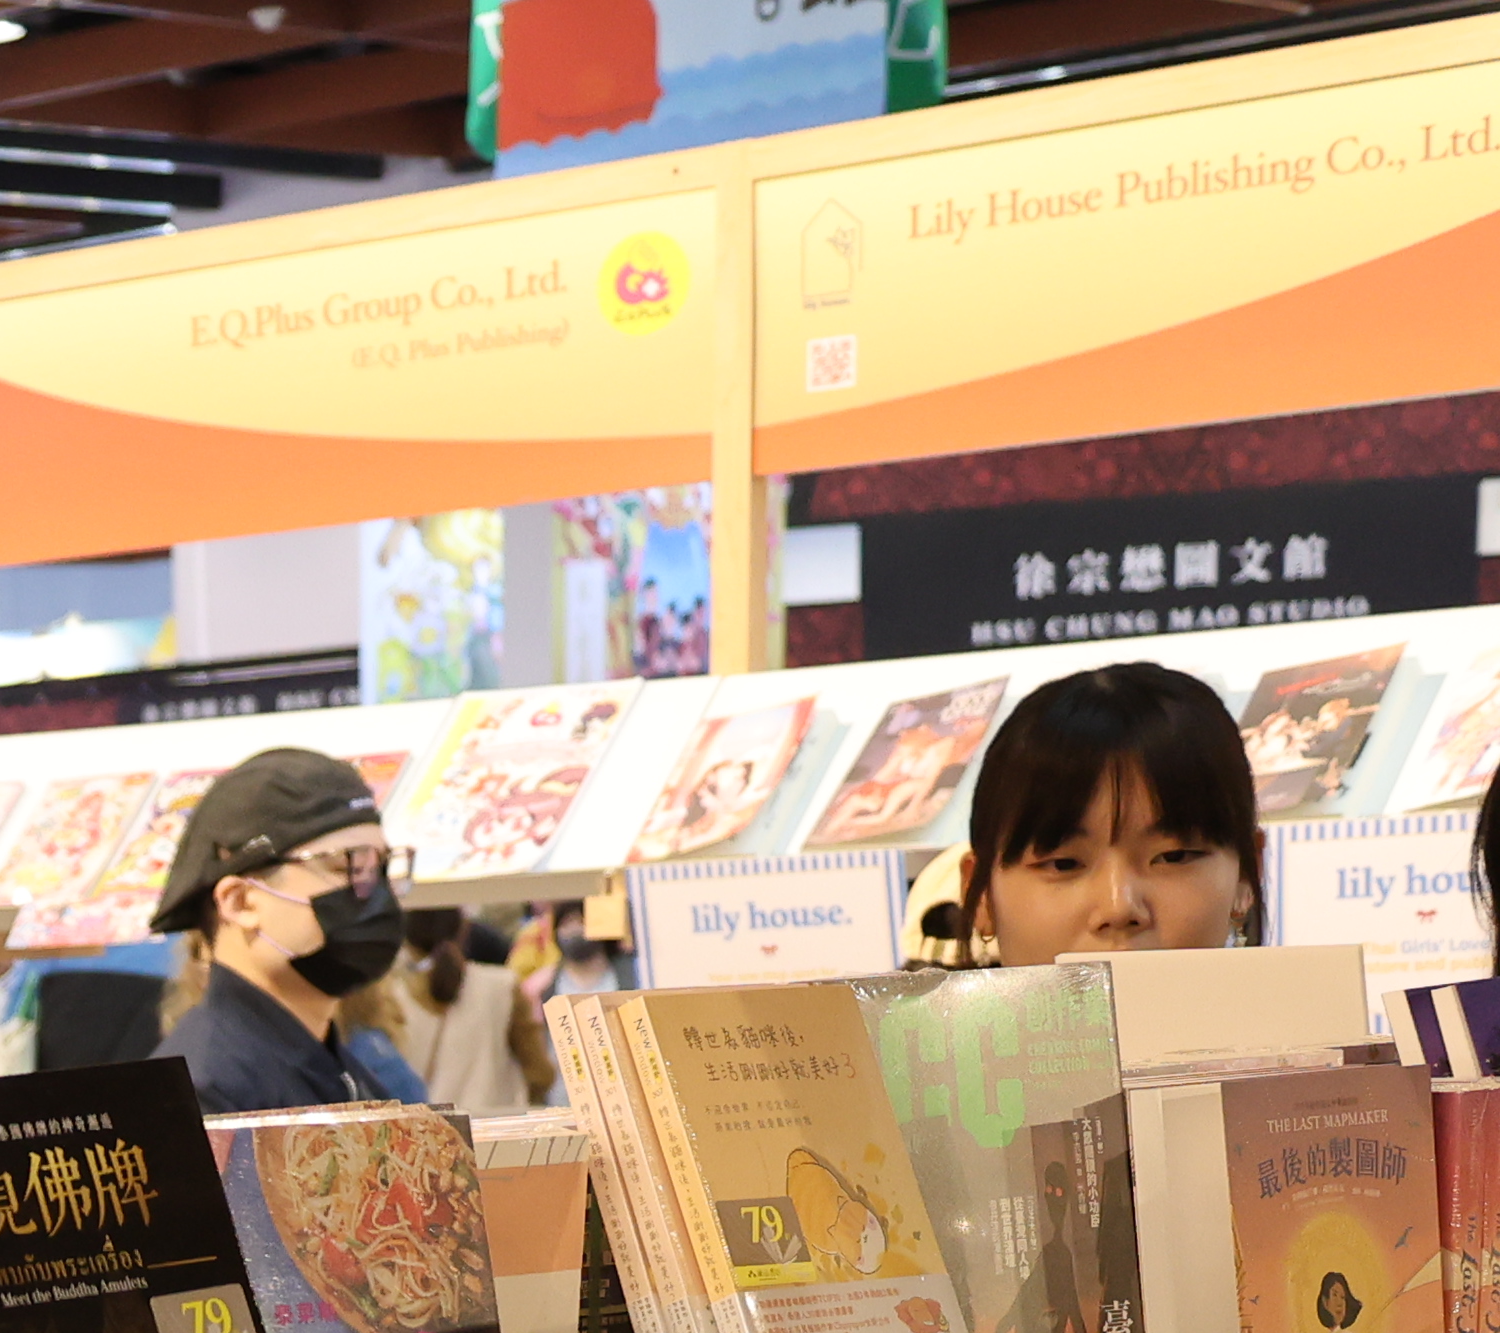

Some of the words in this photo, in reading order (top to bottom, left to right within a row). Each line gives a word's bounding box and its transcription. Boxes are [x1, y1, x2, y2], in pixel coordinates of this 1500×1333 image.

[909, 203, 975, 245] Lily
[986, 181, 1101, 228] House
[1116, 150, 1317, 208] Publishing
[1326, 134, 1406, 175] Co.,
[1420, 113, 1500, 163] Ltd.
[324, 287, 421, 332] Group
[431, 275, 496, 308] Co.,
[505, 261, 568, 300] Ltd.
[1012, 533, 1329, 601] 徐宗懋圖文館
[970, 617, 1036, 648] HSU
[1045, 608, 1160, 643] CHUNG
[1168, 603, 1241, 633] MAO
[1248, 593, 1370, 627] STUDIO
[1337, 868, 1395, 907] lily
[692, 901, 739, 935] lily
[747, 901, 853, 930] house.
[1266, 1117, 1292, 1135] THE
[1293, 1114, 1322, 1133] LAST
[1323, 1108, 1390, 1129] MAPMAKER
[1257, 1136, 1408, 1201] 最後的製圖師
[740, 1204, 786, 1245] 79
[0, 1289, 29, 1309] Meet
[31, 1287, 51, 1305] the
[53, 1282, 99, 1304] Buddha
[100, 1275, 149, 1296] Amulets
[1458, 1248, 1480, 1322] Last
